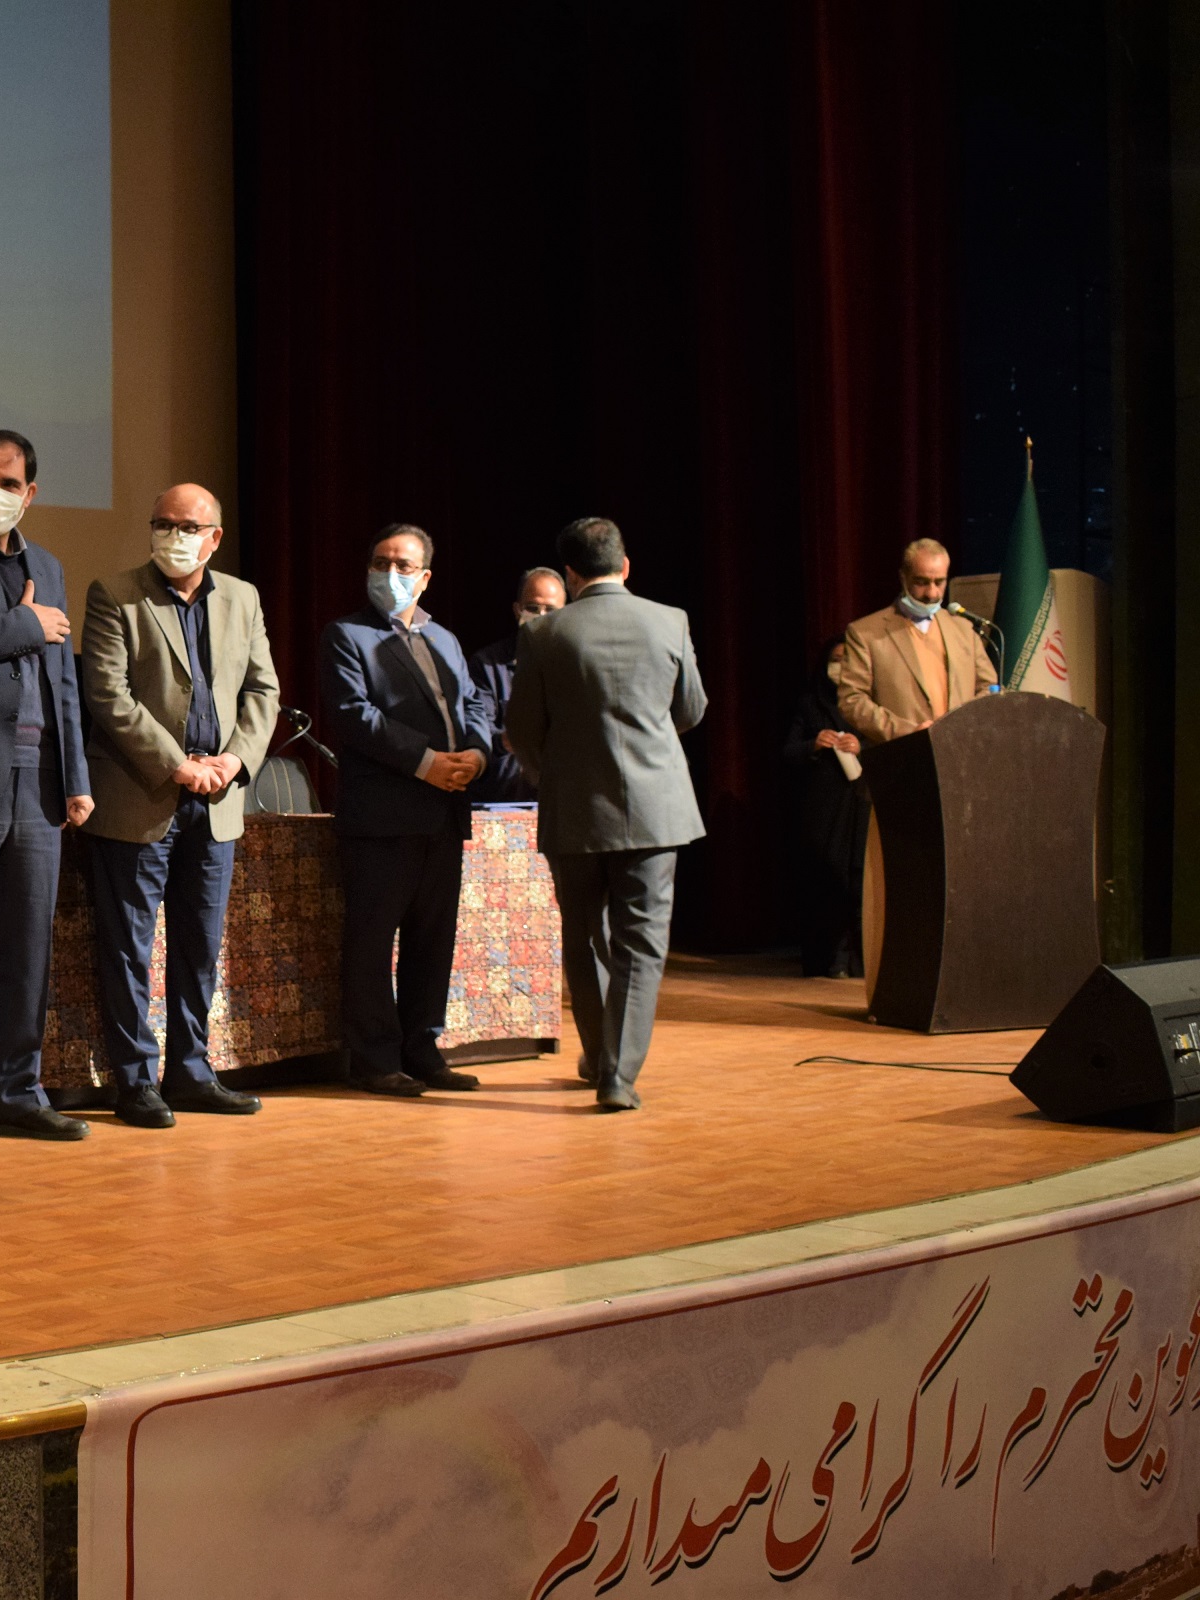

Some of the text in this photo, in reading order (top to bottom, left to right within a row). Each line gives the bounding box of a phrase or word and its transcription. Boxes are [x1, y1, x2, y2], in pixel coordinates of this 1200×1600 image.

[764, 1275, 990, 1577] گرامی
[941, 1376, 987, 1488] را
[991, 1272, 1134, 1562] محترم
